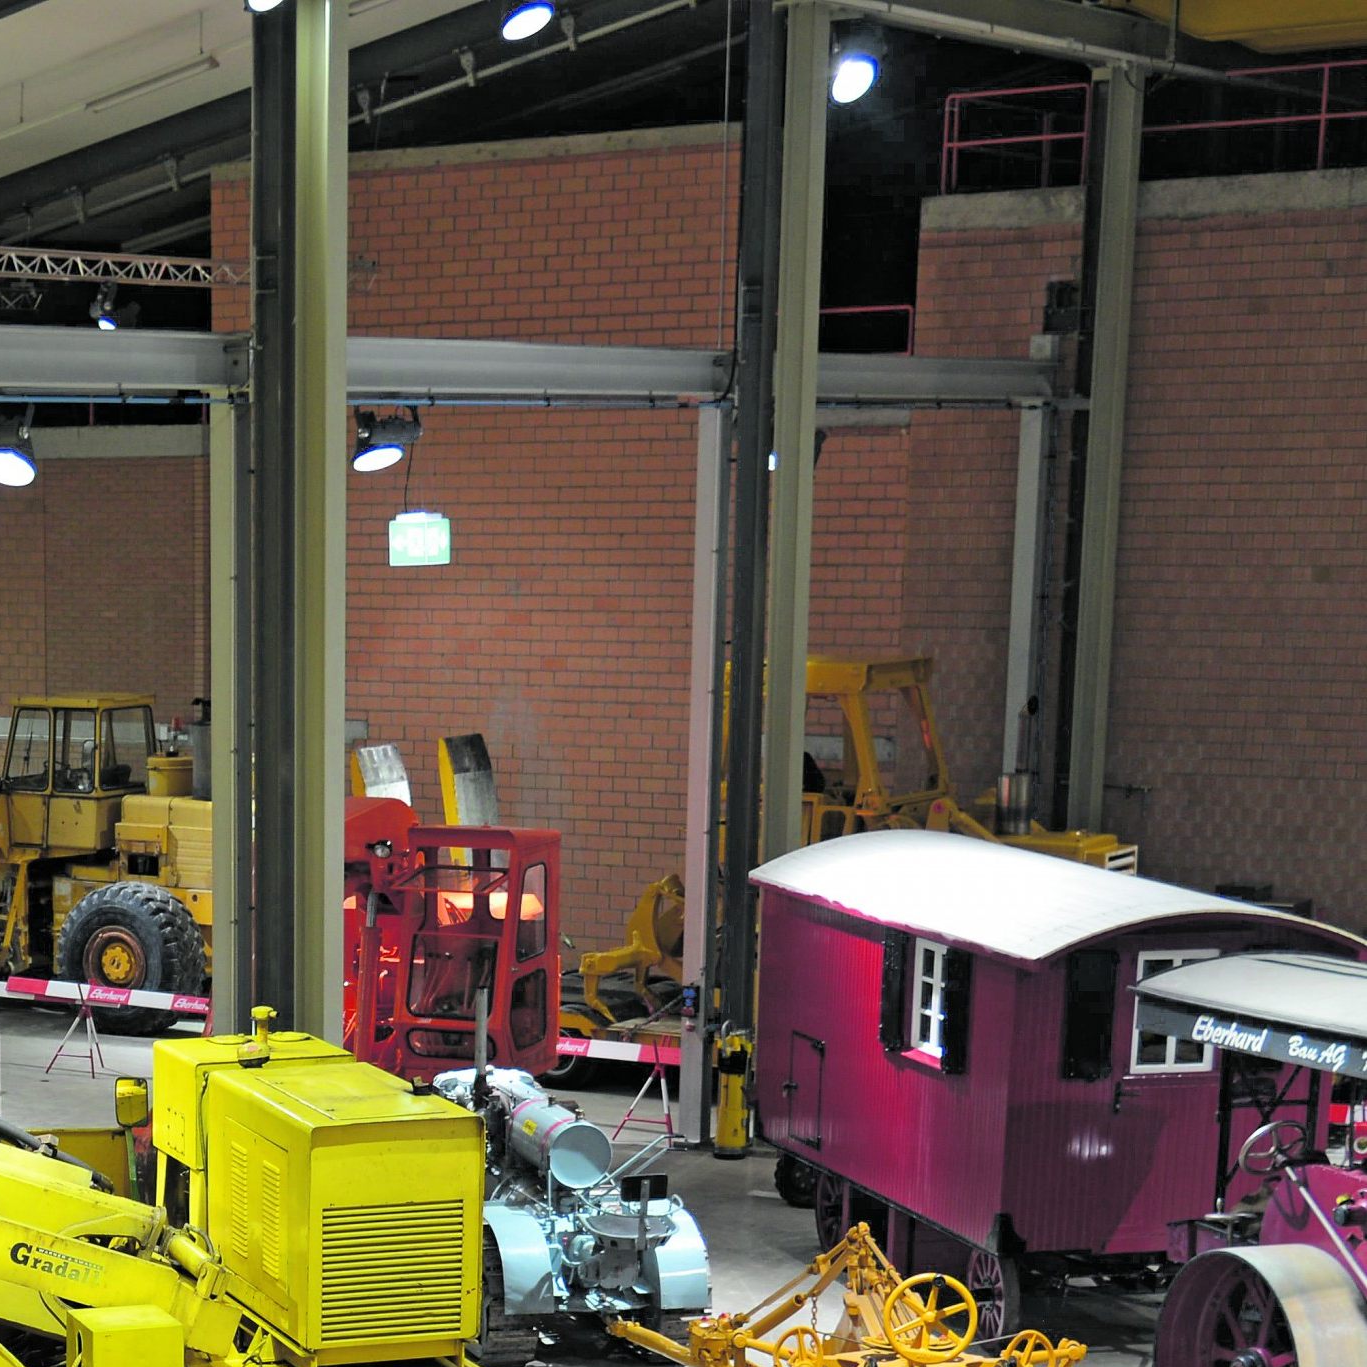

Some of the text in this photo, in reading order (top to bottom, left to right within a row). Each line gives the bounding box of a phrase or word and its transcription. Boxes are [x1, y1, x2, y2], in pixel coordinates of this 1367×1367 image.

[89, 988, 128, 1001] Eberhard
[1191, 1014, 1268, 1053] Eberhard
[1288, 1034, 1318, 1062] Bau
[1317, 1043, 1347, 1072] AG
